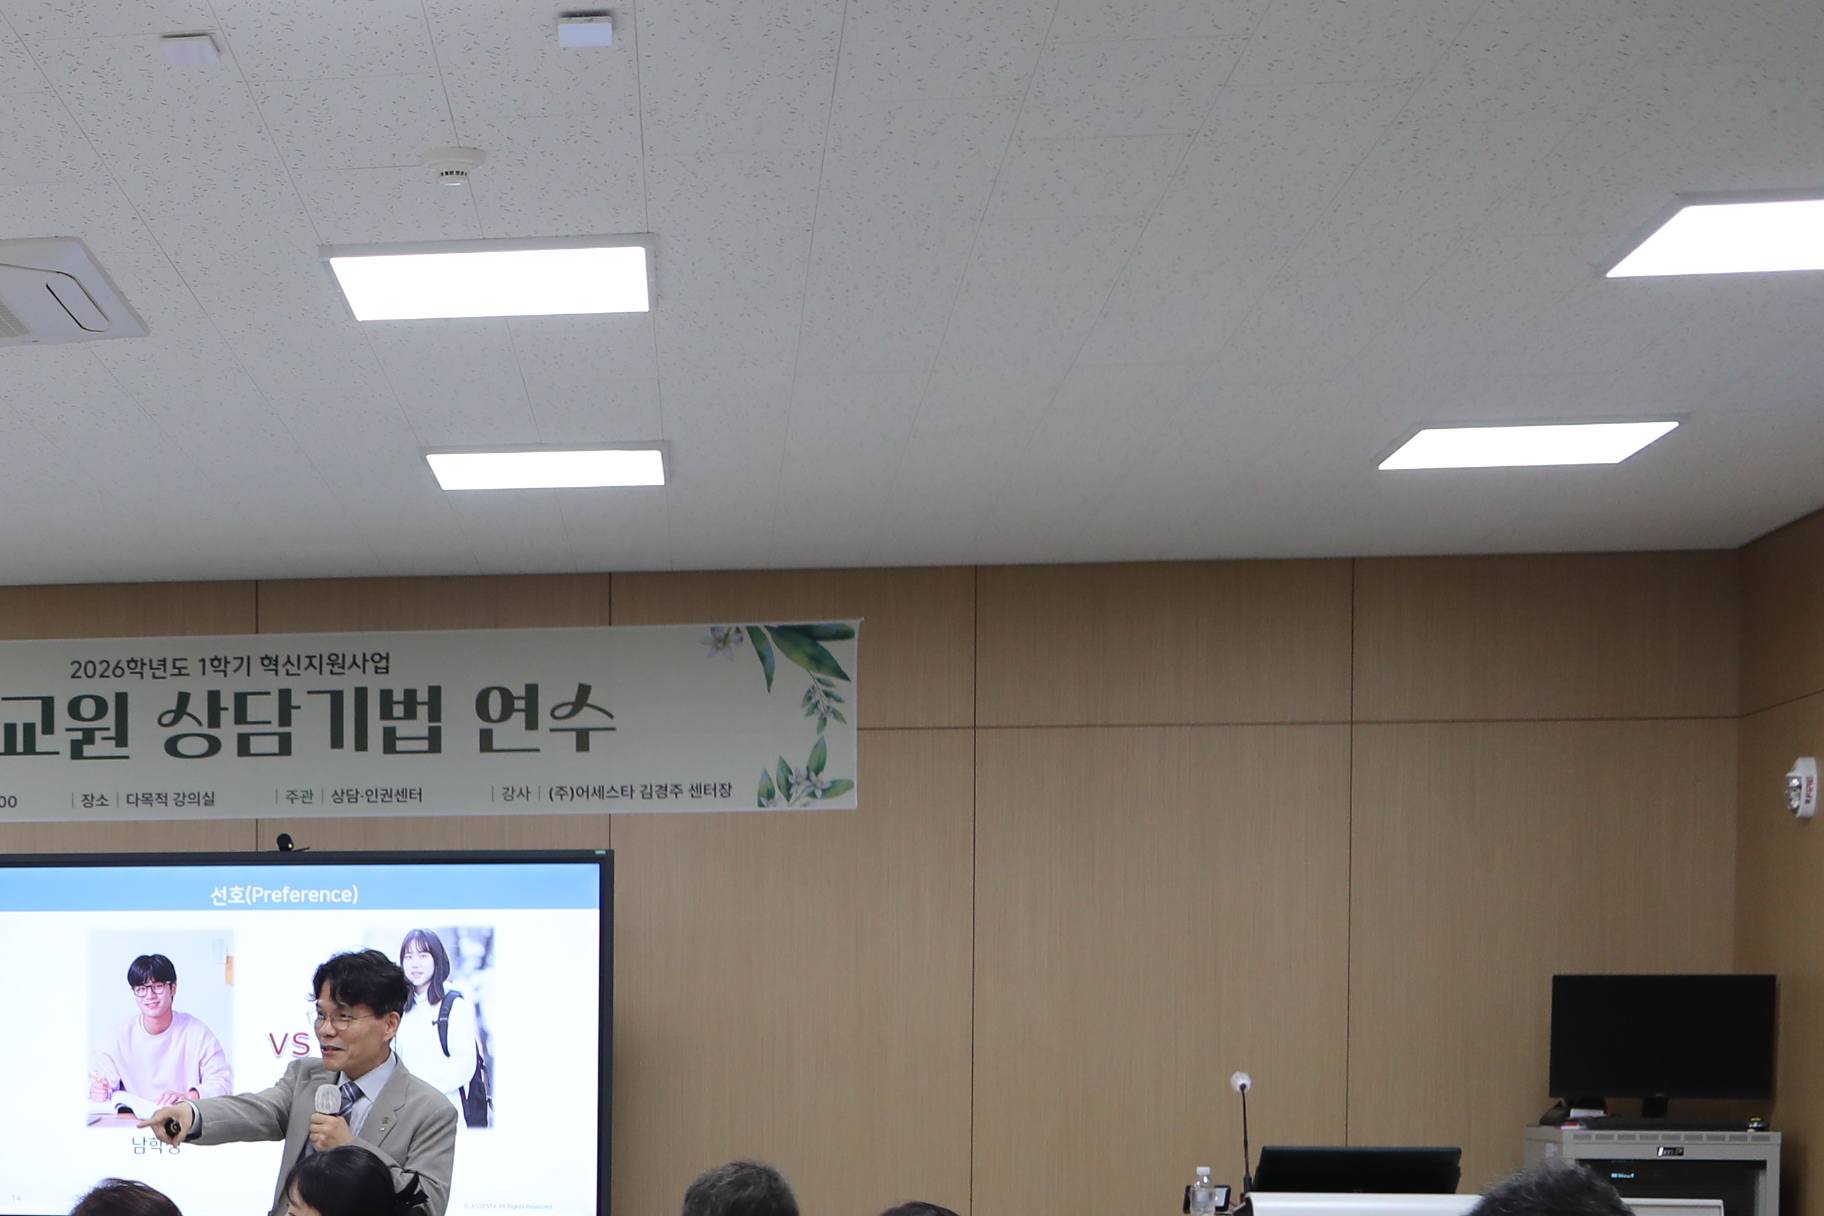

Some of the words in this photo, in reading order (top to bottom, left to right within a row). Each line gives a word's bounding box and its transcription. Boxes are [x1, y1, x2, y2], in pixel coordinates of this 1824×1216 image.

[70, 655, 191, 681] 2026학년도
[197, 653, 252, 679] 1학기
[259, 650, 390, 678] 혁신지원사업
[156, 684, 443, 760] 상담기법
[474, 682, 617, 754] 연수
[80, 791, 110, 809] 장소
[125, 791, 169, 809] 다목적
[172, 790, 216, 808] 강의실
[285, 788, 315, 805] 주관
[330, 786, 423, 805] 상담·인권센터
[501, 784, 532, 802] 강사
[548, 783, 636, 803] (주)어세스타
[639, 783, 684, 801] 김경주
[688, 781, 733, 799] 센터장
[209, 882, 359, 906] 선호(Preference)
[269, 1032, 310, 1056] VS
